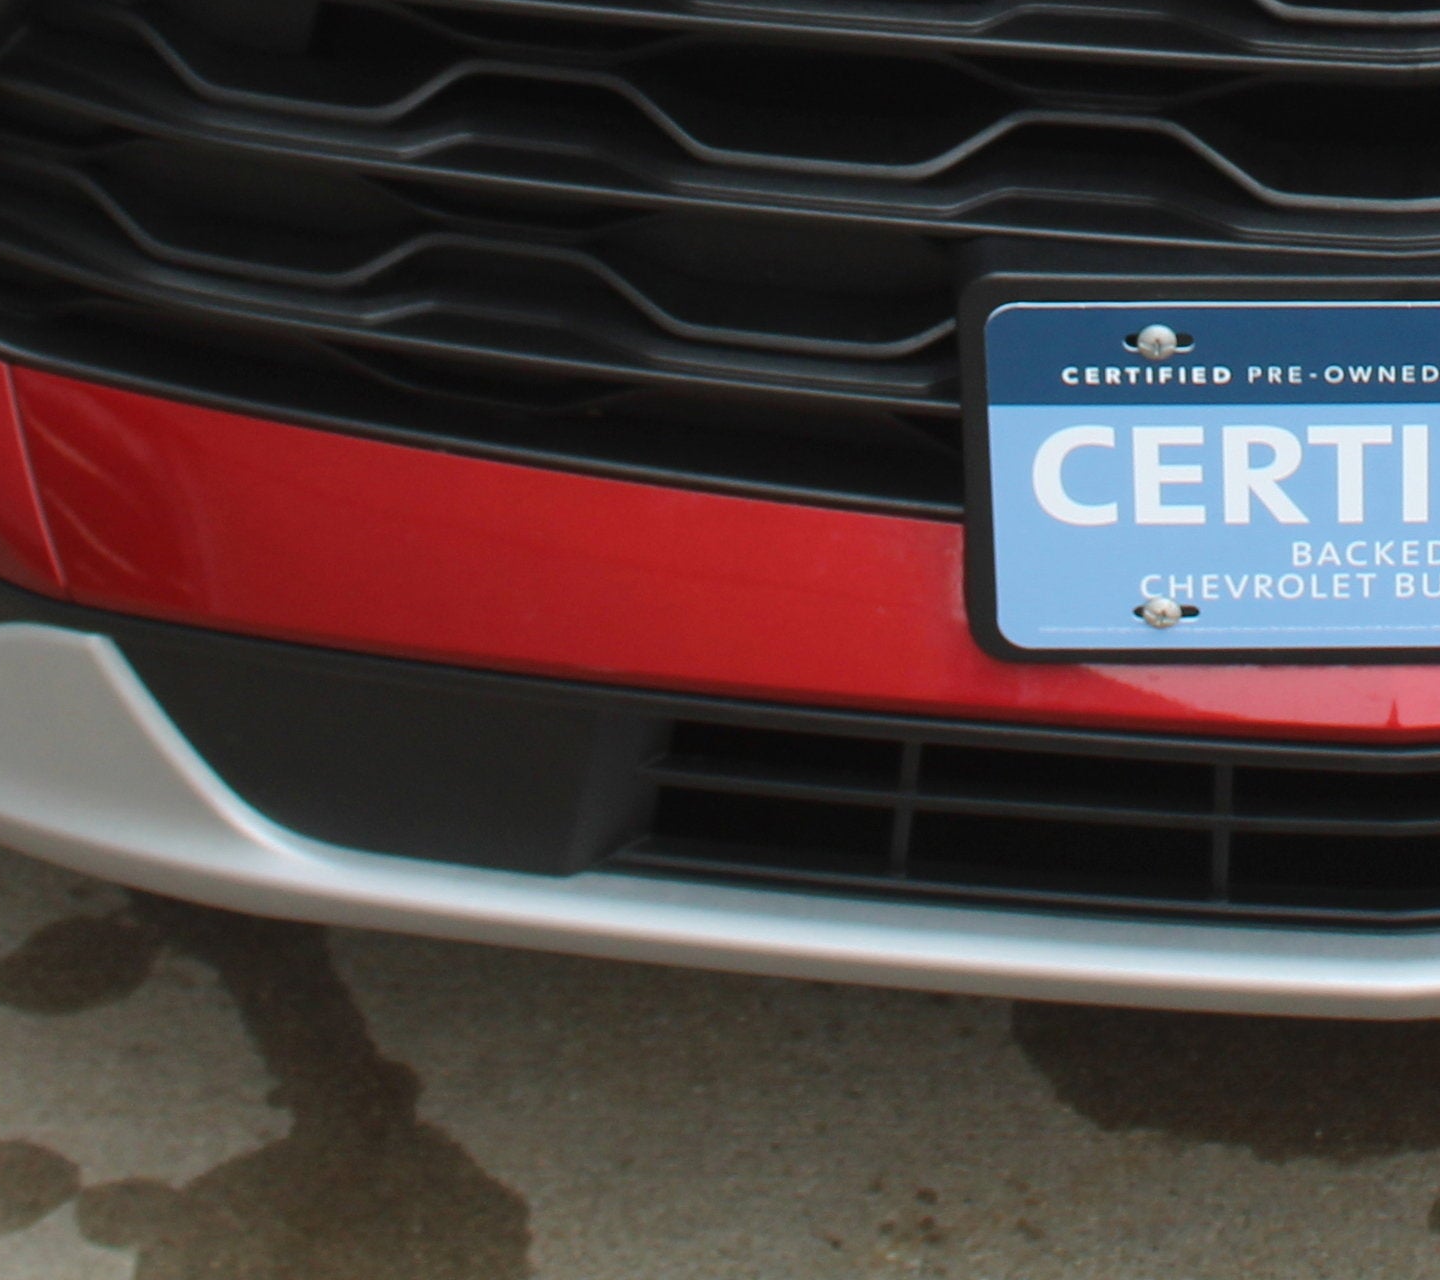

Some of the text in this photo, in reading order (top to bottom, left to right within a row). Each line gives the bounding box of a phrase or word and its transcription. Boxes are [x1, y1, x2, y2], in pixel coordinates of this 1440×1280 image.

[1060, 365, 1232, 386] CERTIFIED
[1247, 364, 1440, 385] PRE-OWNED
[1139, 572, 1377, 600] CHEVROLET
